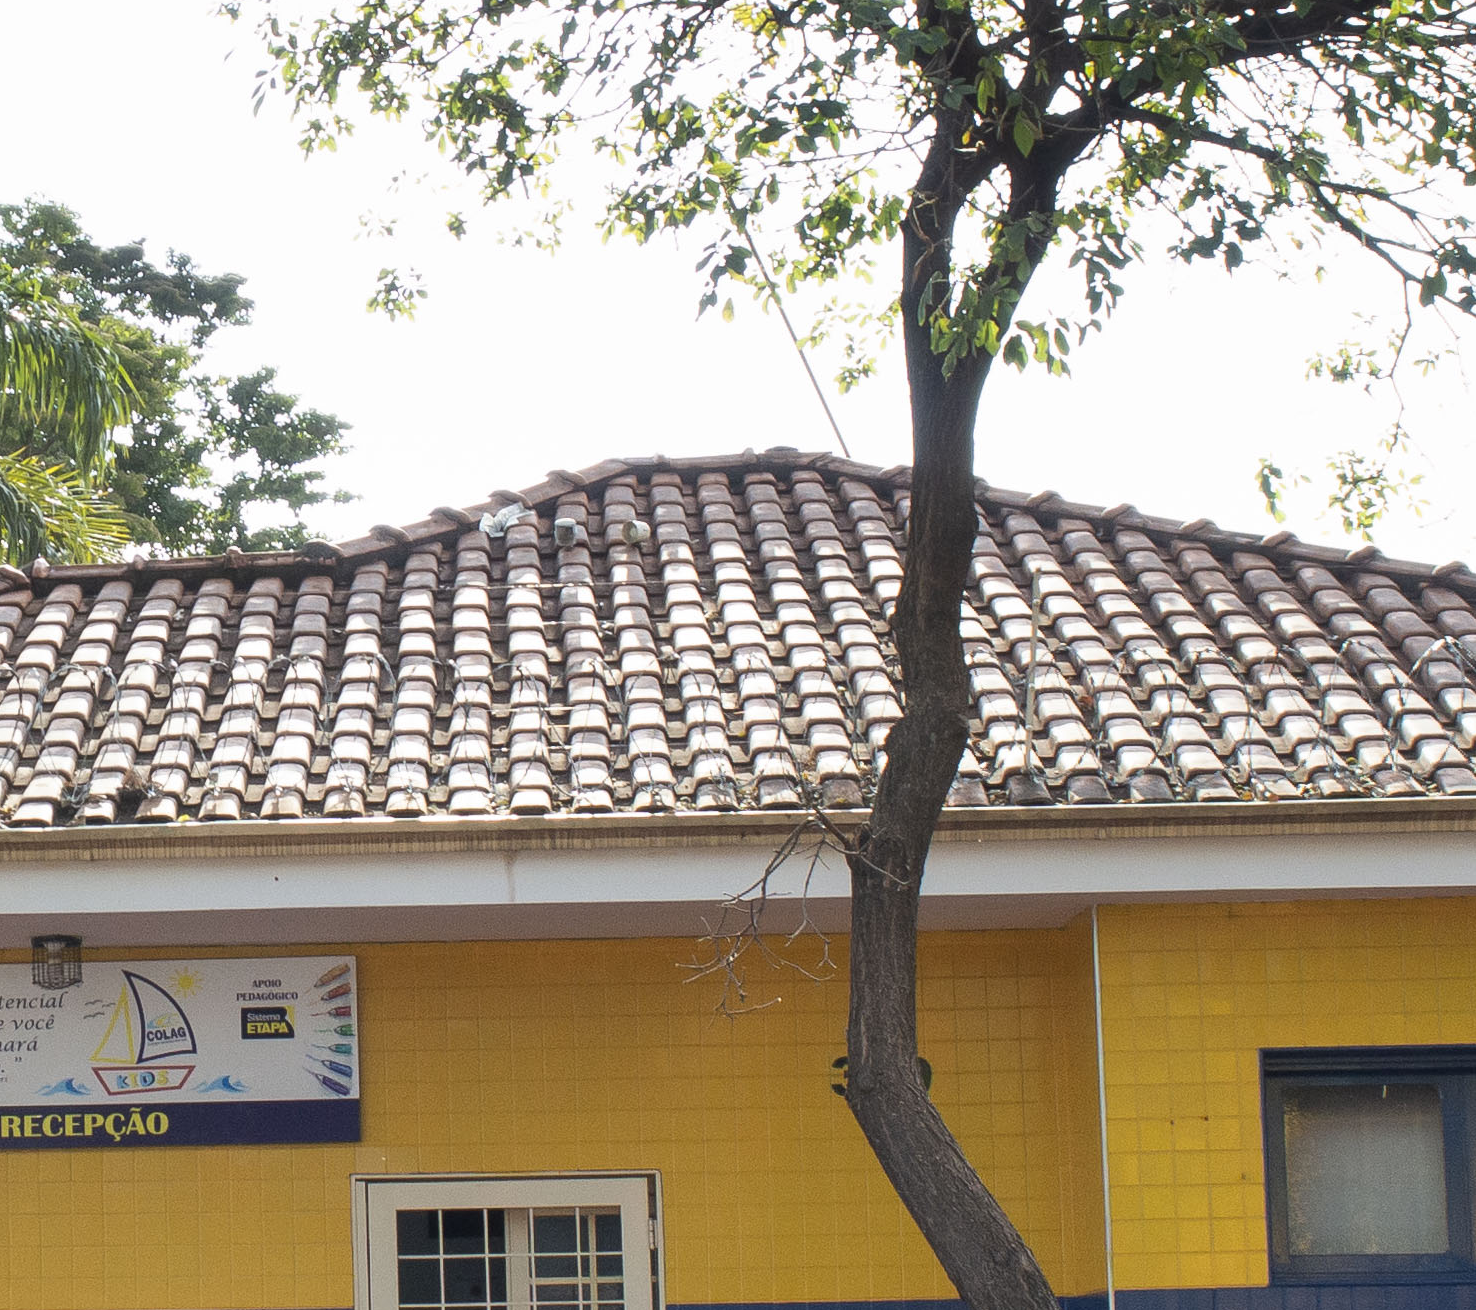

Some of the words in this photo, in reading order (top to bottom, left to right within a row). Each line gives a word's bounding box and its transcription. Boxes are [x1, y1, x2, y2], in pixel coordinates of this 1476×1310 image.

[252, 979, 282, 988] APOIO
[11, 1014, 55, 1031] você
[247, 1012, 281, 1021] Sistema
[146, 1026, 187, 1042] COLAG
[247, 1022, 289, 1034] ETAPA
[116, 1070, 169, 1089] KIDS
[0, 1107, 169, 1141] RECEPÇÃO
